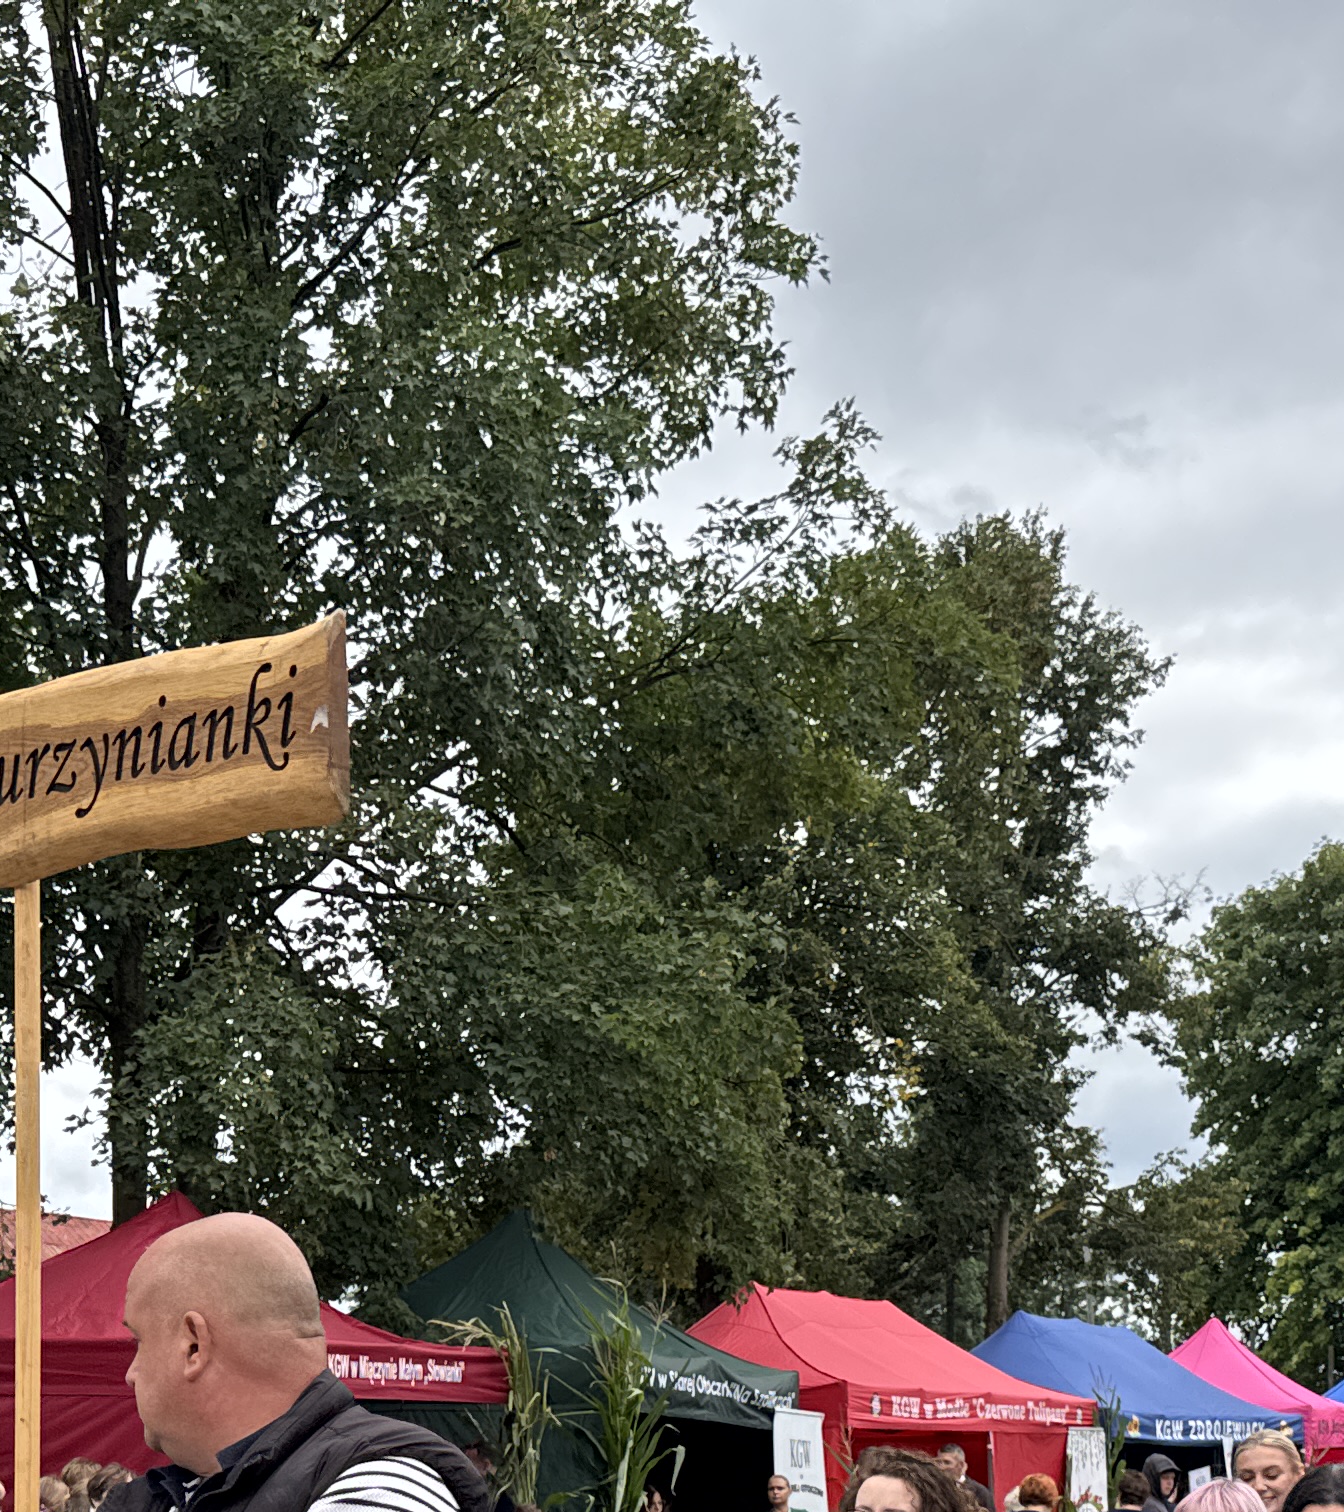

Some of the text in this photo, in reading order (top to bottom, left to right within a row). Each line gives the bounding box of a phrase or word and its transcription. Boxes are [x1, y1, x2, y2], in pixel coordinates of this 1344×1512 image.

[327, 1353, 350, 1379] KGW
[350, 1361, 358, 1378] w
[657, 1372, 667, 1389] w
[891, 1395, 921, 1419] KGW
[923, 1403, 934, 1419] w
[1155, 1418, 1184, 1440] KGW
[789, 1439, 812, 1469] KGW
